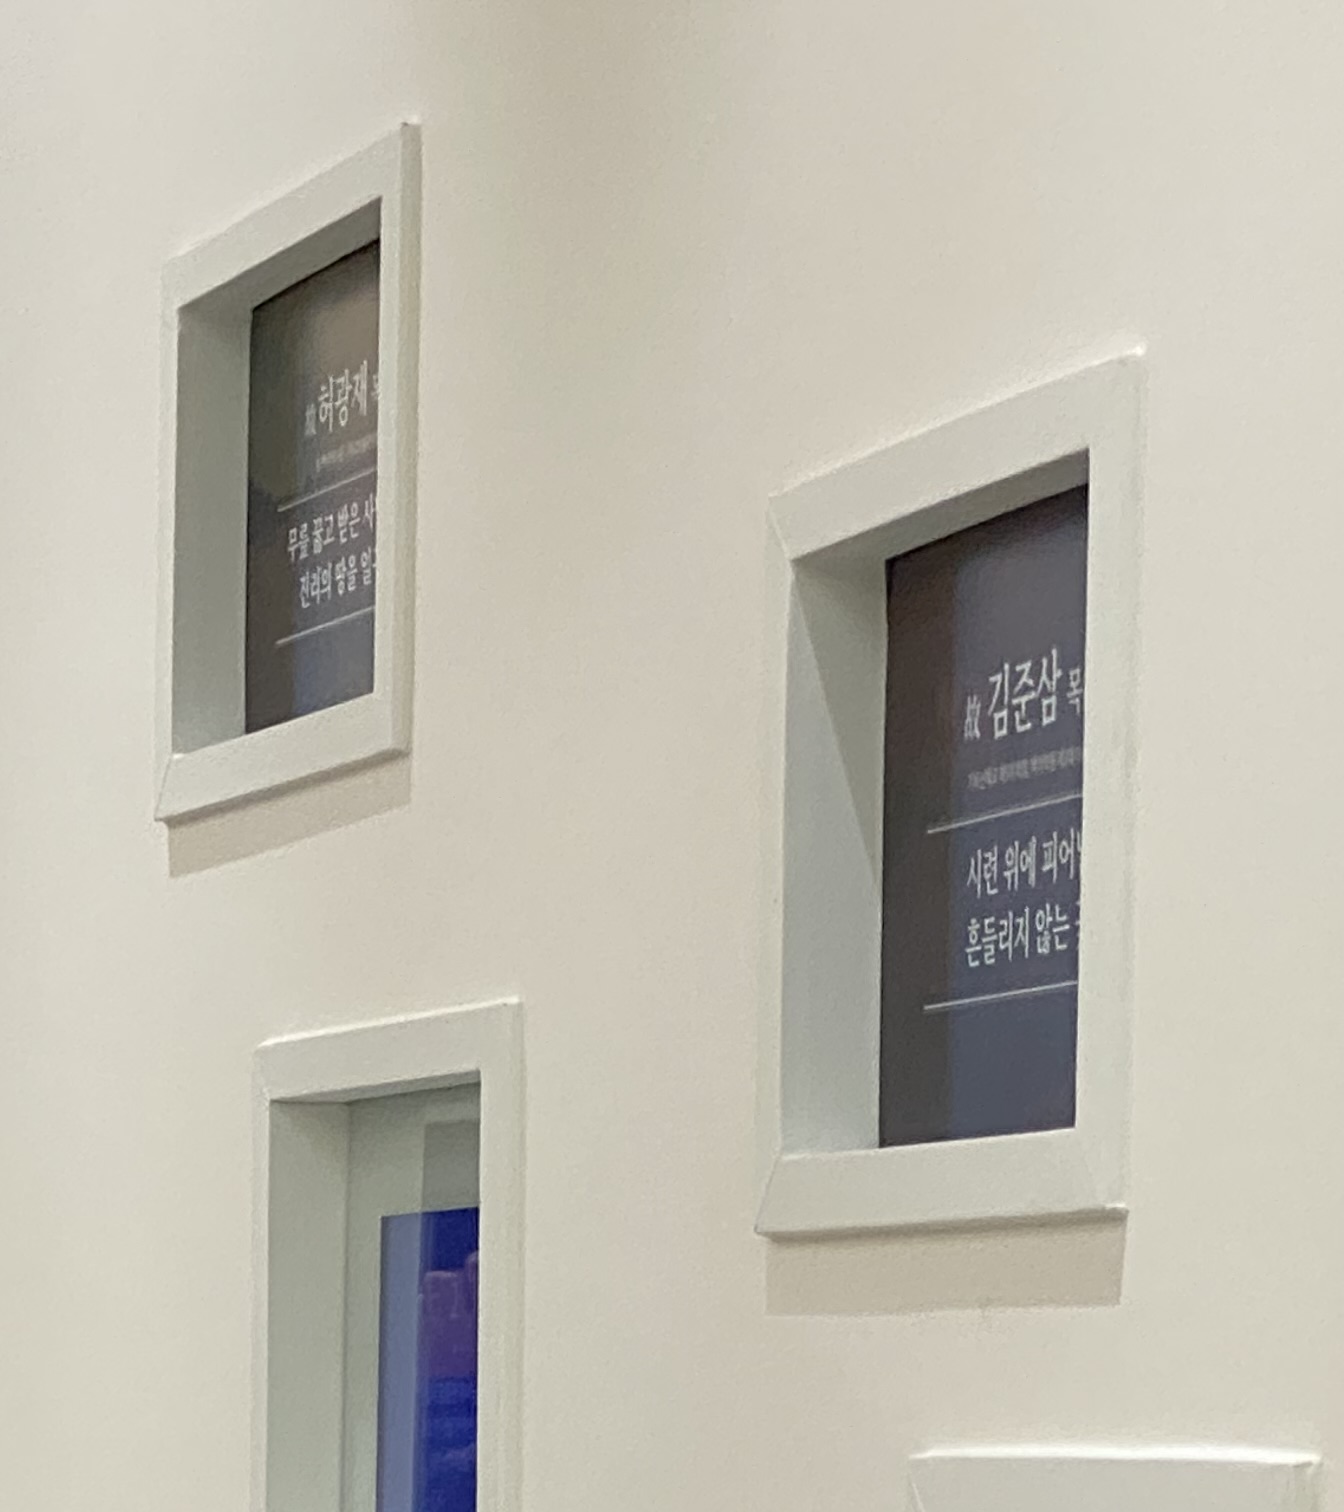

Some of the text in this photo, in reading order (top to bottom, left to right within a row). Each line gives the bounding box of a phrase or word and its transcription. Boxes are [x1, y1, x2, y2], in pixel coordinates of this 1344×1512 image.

[317, 359, 368, 433] 허광재
[337, 502, 361, 541] 받은
[298, 562, 332, 610] 진리의
[988, 648, 1061, 740] 김준삼
[967, 827, 1082, 899] 시련 위에 피어
[965, 907, 1029, 967] 흔들리지
[1036, 903, 1070, 955] 않는
